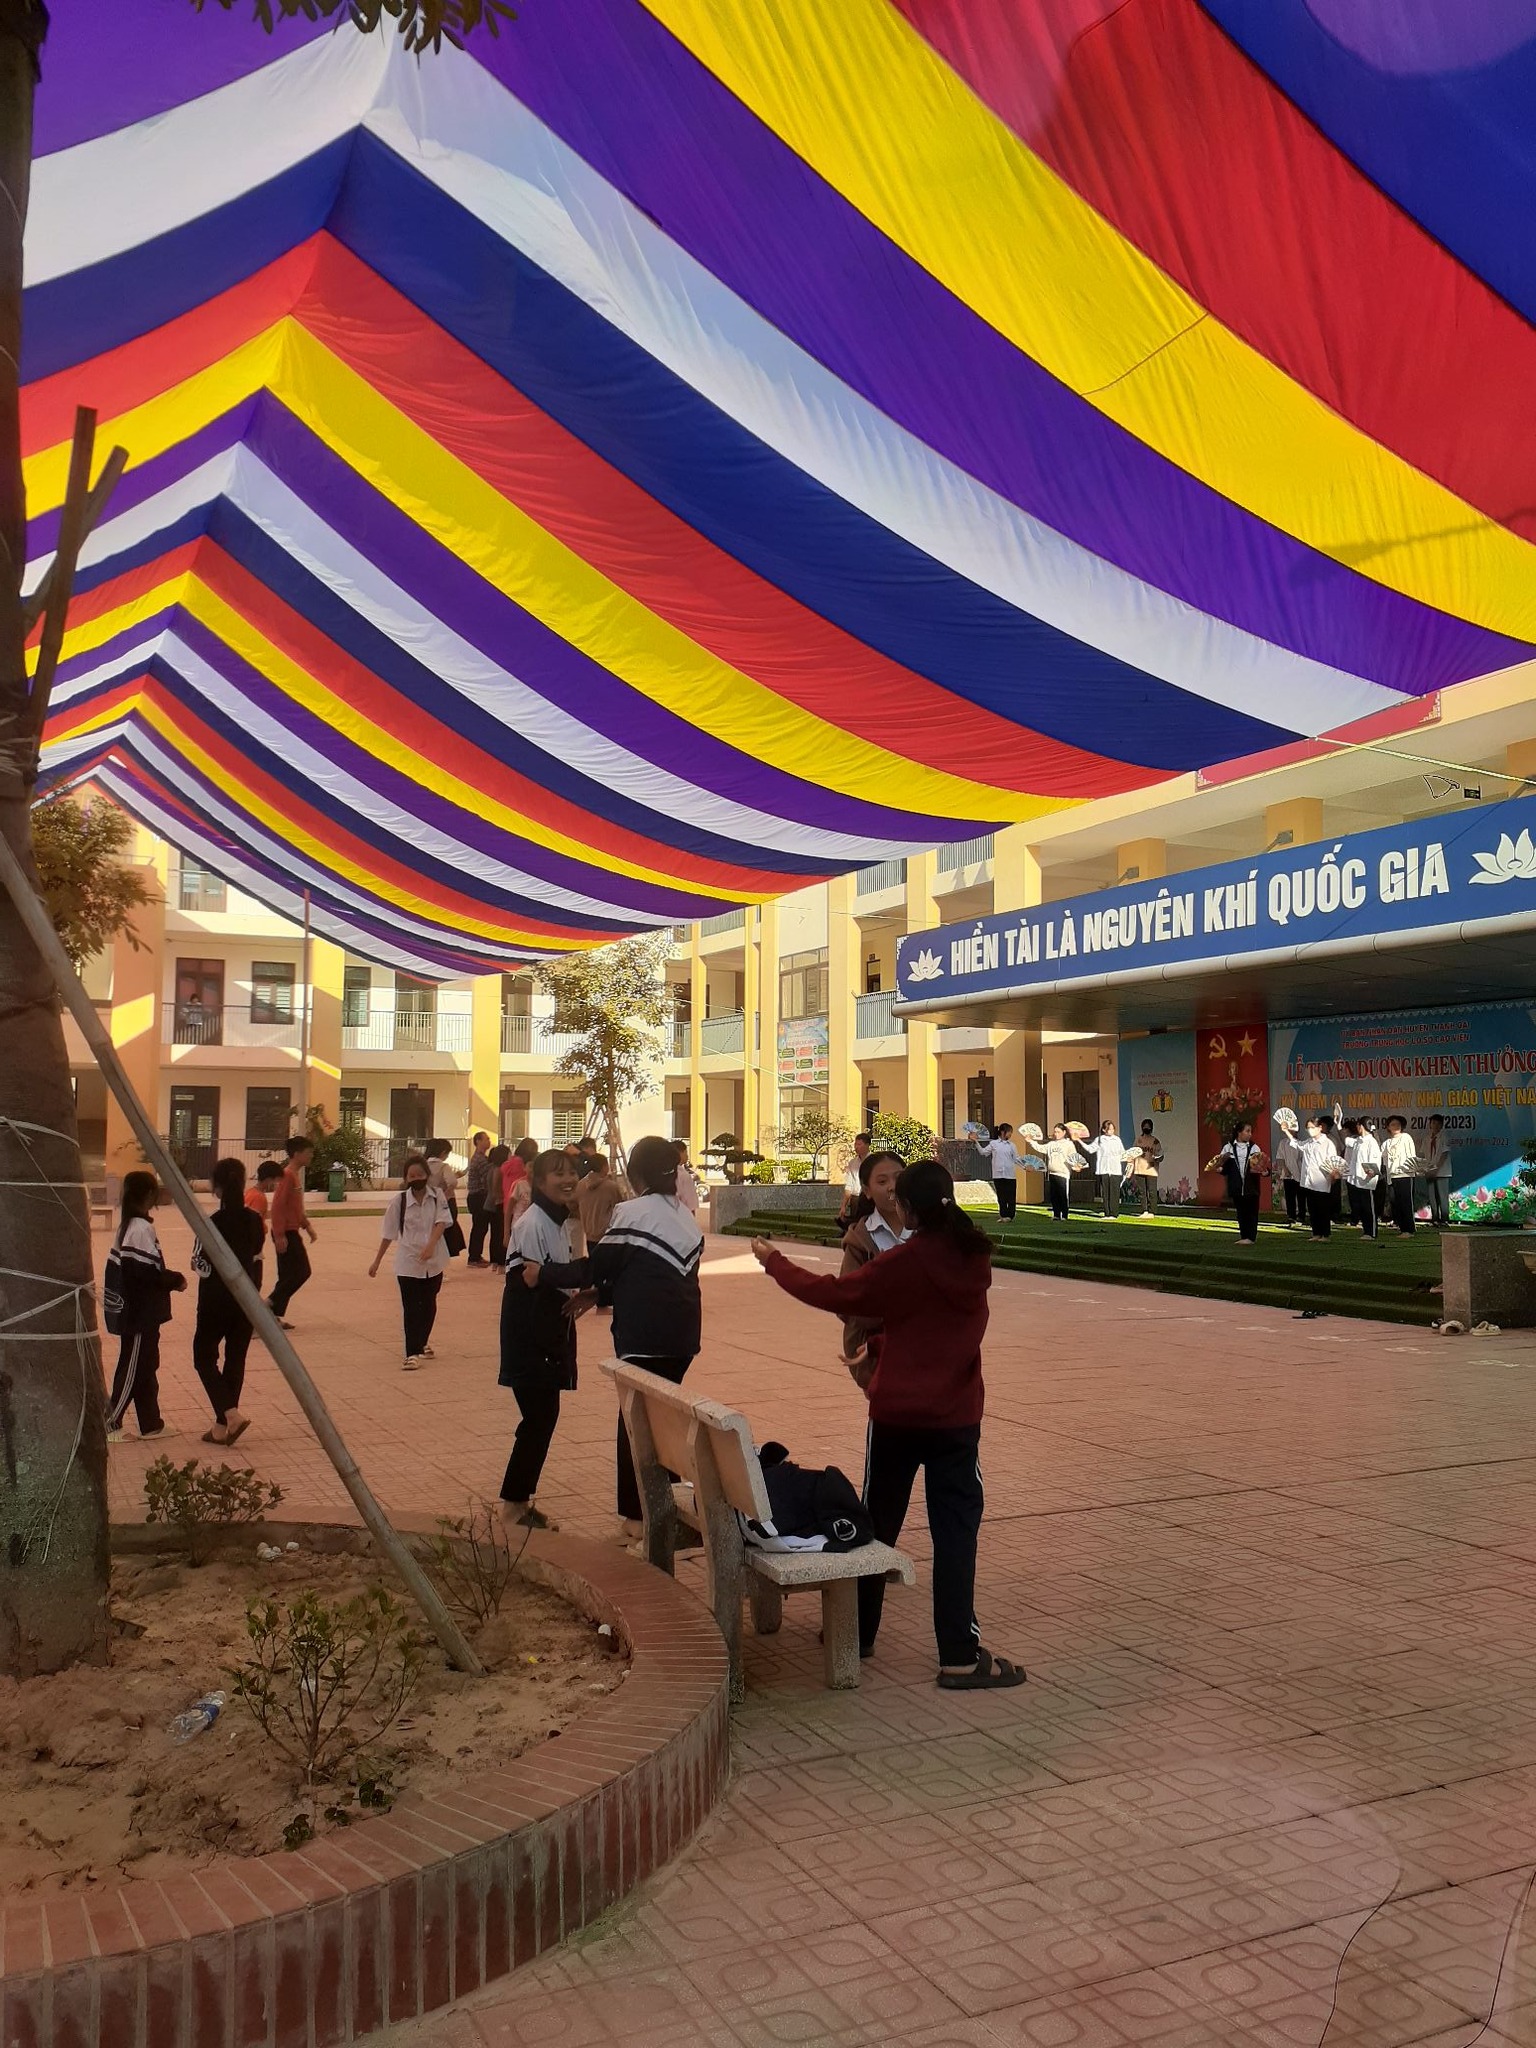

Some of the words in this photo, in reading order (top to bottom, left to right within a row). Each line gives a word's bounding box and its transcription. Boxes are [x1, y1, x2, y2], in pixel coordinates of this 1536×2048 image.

[951, 921, 999, 976] HIỀN
[1004, 918, 1040, 967] TÀI
[1045, 910, 1078, 960] LÀ
[1083, 887, 1194, 953] NGUYÊN
[1203, 869, 1259, 934] KHÍ
[1268, 843, 1367, 926] QUỐC
[1379, 842, 1450, 904] GIA
[1287, 1053, 1304, 1081] LỄ
[1306, 1054, 1355, 1081] TUYÊN
[1356, 1053, 1412, 1080] DƯƠNG
[1413, 1054, 1460, 1077] KHEN
[1447, 1084, 1479, 1107] GIÁO
[1482, 1084, 1513, 1110] VIỆT
